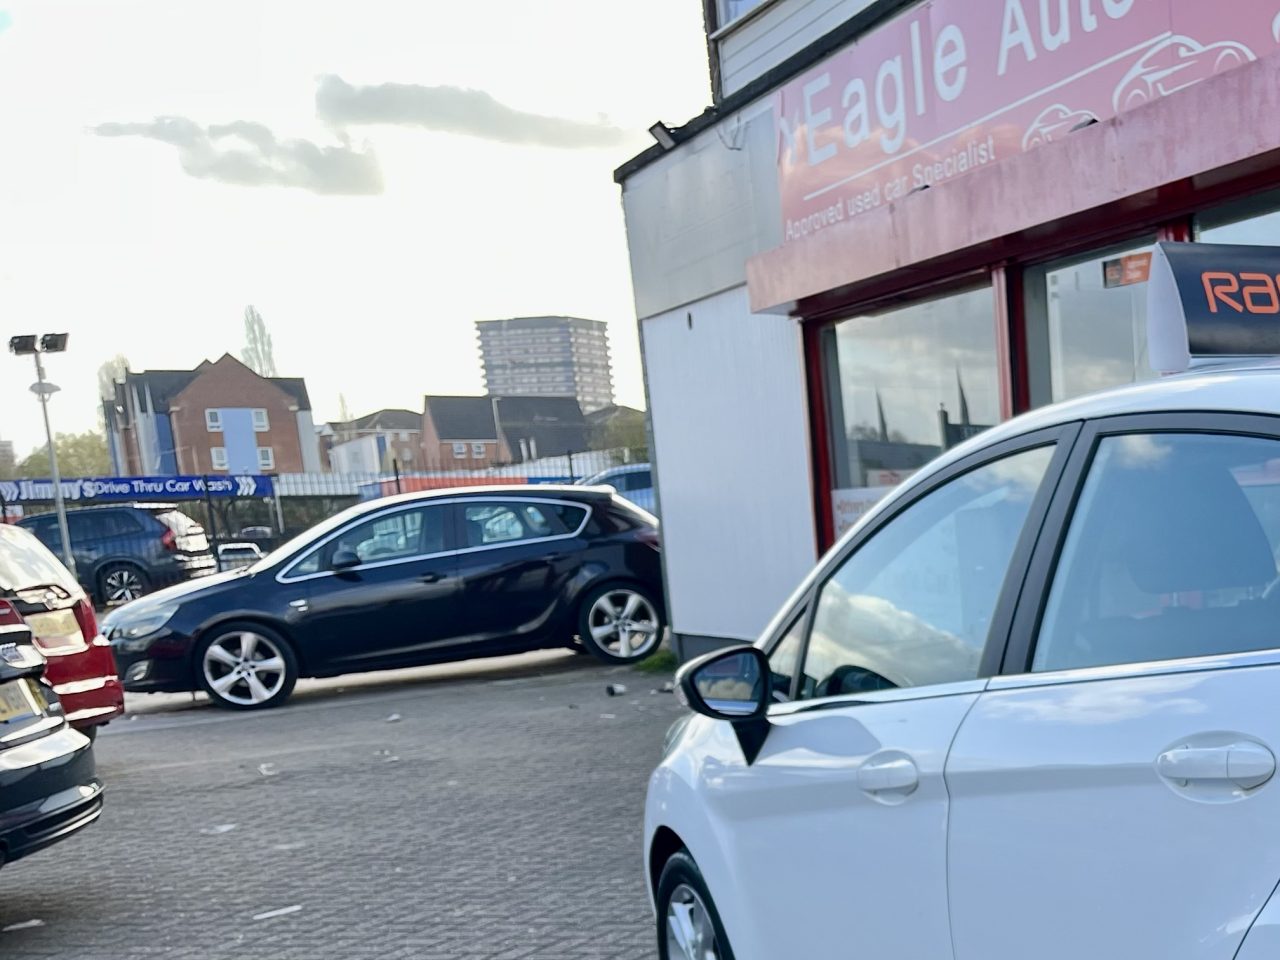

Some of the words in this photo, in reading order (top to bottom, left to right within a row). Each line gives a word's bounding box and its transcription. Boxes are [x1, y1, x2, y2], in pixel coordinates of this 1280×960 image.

[803, 21, 967, 167] Eagle
[997, 0, 1136, 76] Au
[785, 202, 844, 241] Approved
[847, 182, 881, 216] used
[884, 174, 908, 201] car
[912, 134, 996, 186] Specialist
[131, 479, 164, 494] Thru
[165, 479, 192, 493] Car
[192, 477, 233, 492] Wash
